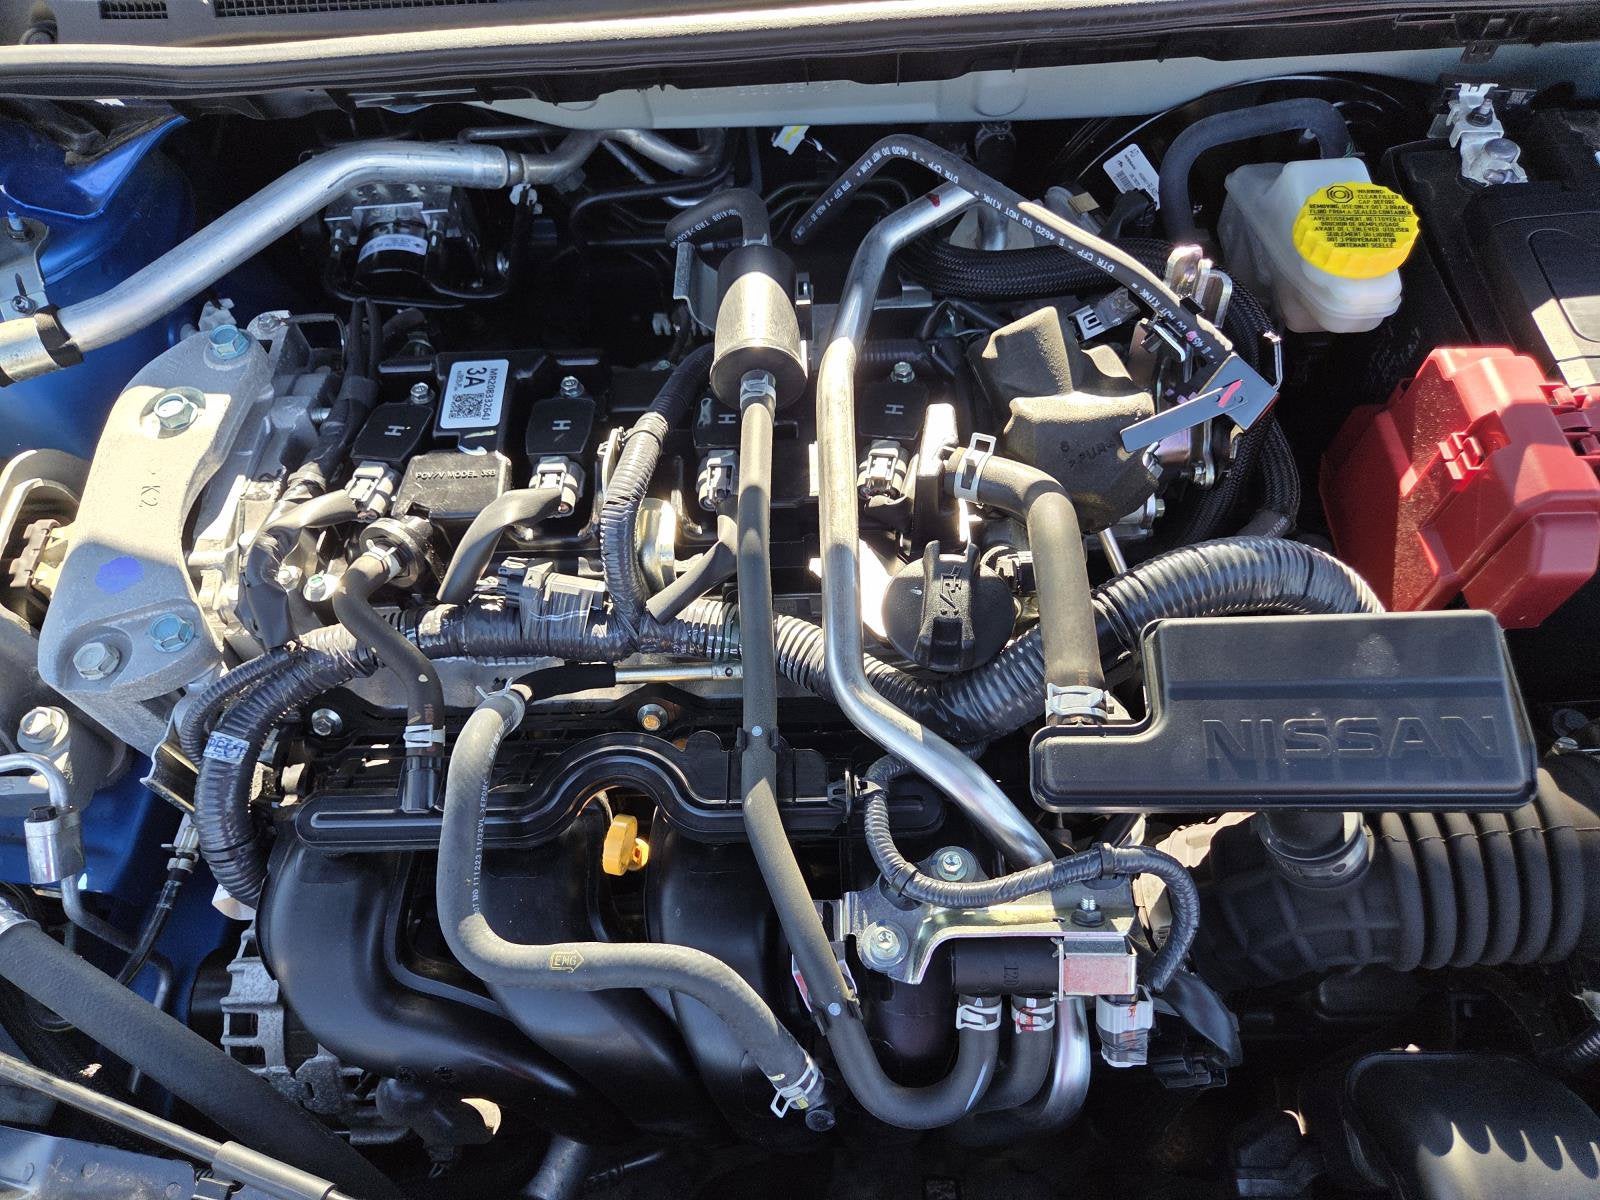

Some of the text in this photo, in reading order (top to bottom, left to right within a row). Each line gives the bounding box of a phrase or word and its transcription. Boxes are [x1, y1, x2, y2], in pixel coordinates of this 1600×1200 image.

[891, 146, 909, 156] 4620
[983, 193, 1002, 210] KINK
[1004, 207, 1020, 221] NOT
[1021, 216, 1033, 229] DO
[1035, 225, 1056, 240] 4620
[1077, 249, 1094, 261] CFP
[1096, 257, 1115, 273] DTR
[1140, 288, 1161, 308] KINK
[464, 367, 488, 388] 3A
[446, 470, 478, 480] MODEL
[1202, 716, 1503, 759] NISSAN
[553, 954, 578, 967] ENG
